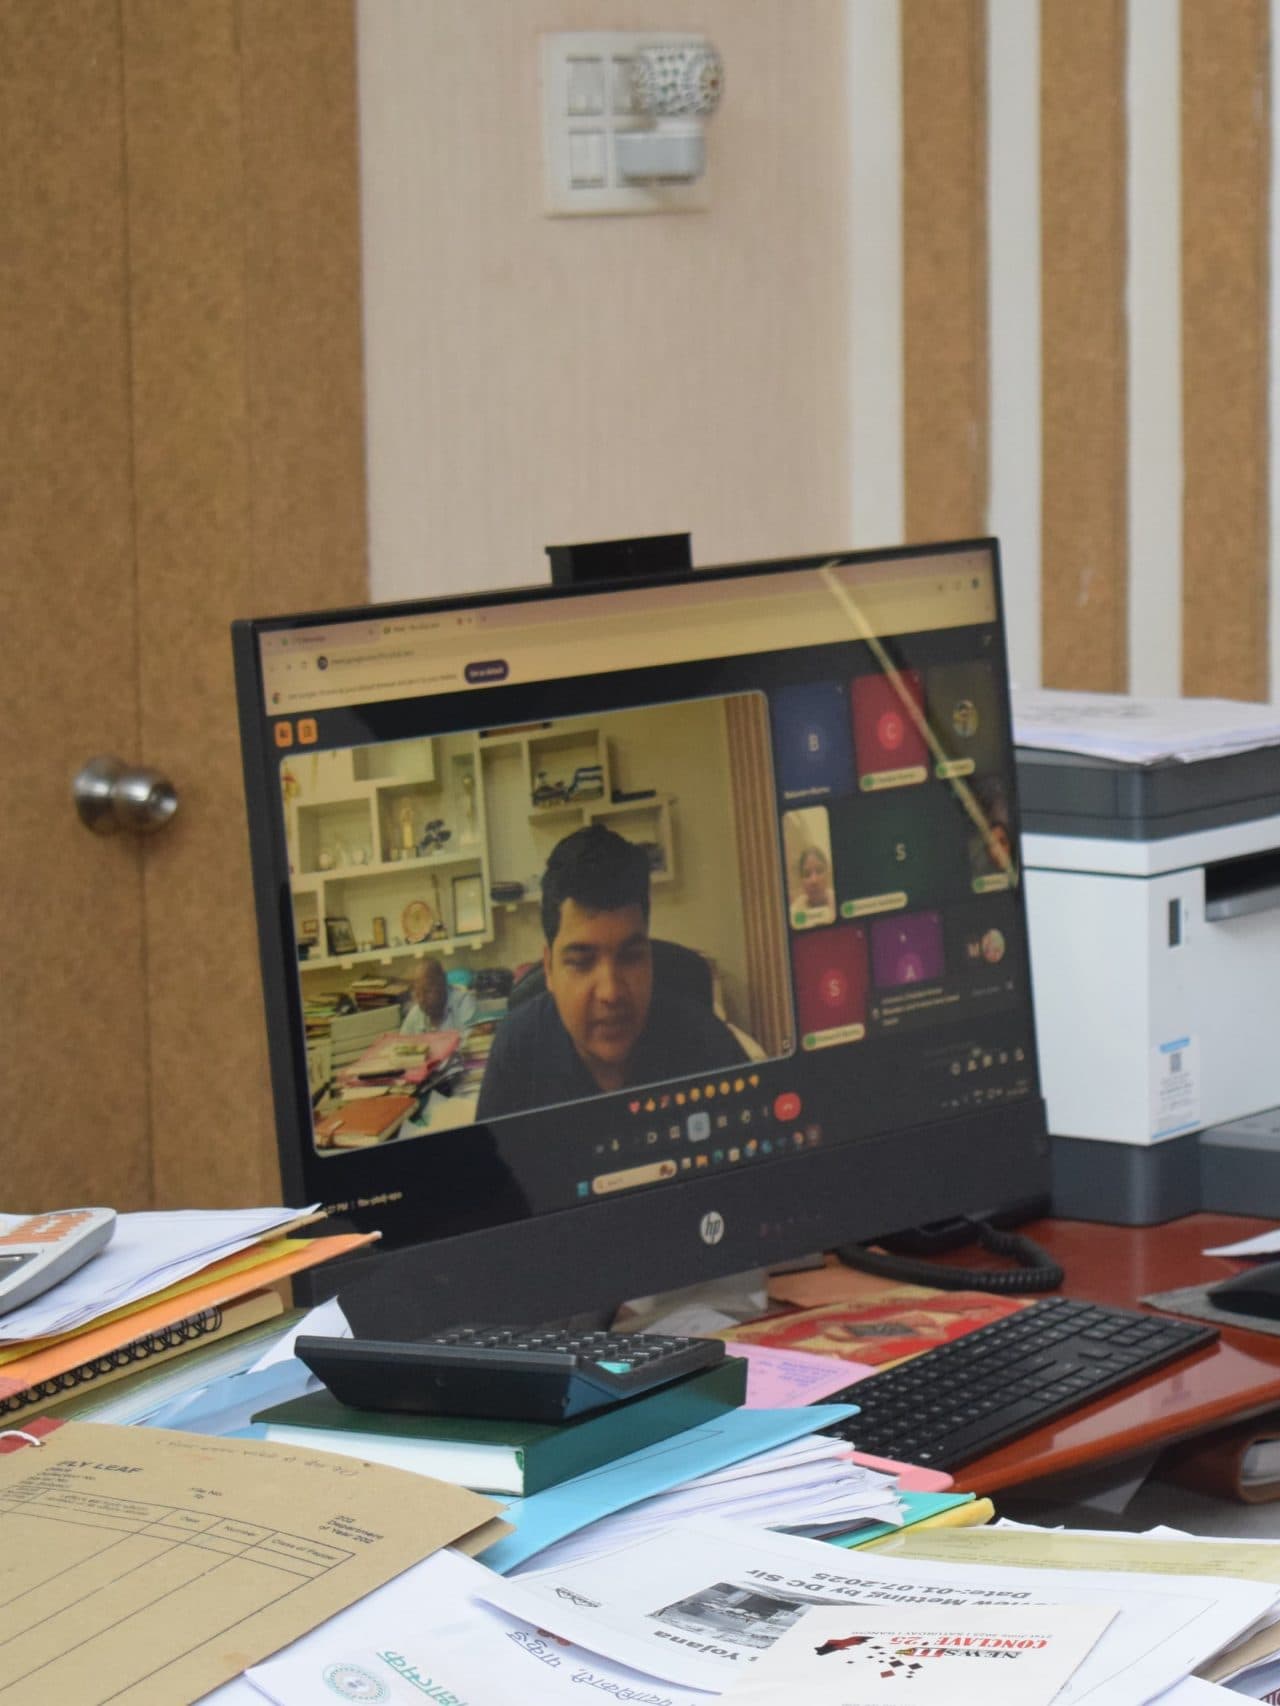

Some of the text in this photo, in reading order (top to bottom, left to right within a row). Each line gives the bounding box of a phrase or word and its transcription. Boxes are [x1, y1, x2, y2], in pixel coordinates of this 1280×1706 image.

[828, 978, 841, 998] S
[702, 1212, 723, 1243] hp
[94, 1462, 145, 1474] LEAF
[746, 1569, 785, 1582] Sir
[786, 1577, 829, 1592] DC
[833, 1584, 861, 1598] by
[653, 1629, 741, 1661] Yojana
[933, 1637, 1049, 1650] CONCLAVE
[376, 1650, 473, 1706] क्षात्मक
